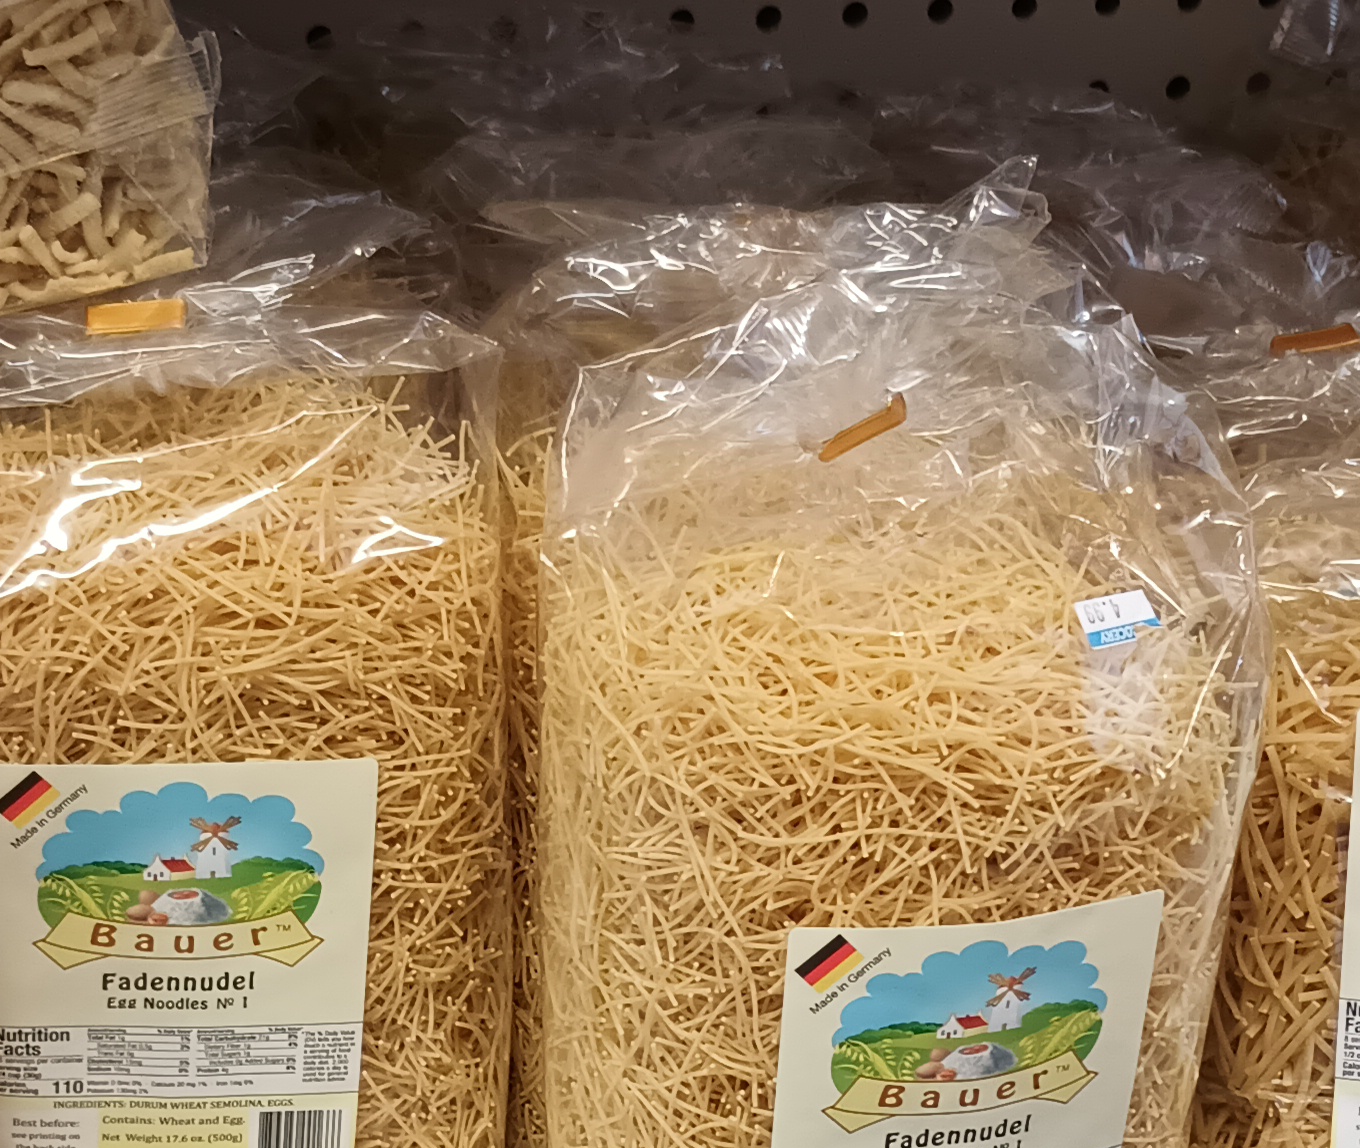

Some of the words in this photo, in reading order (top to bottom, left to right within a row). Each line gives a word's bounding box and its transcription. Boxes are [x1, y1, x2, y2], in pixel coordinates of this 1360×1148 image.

[9, 822, 39, 851] Made
[37, 814, 48, 829] in
[45, 784, 89, 819] Germany
[90, 922, 268, 955] Bauer
[102, 971, 256, 992] Fadennudel
[809, 991, 840, 1015] Made
[837, 982, 848, 999] in
[847, 947, 892, 985] Germany
[106, 996, 137, 1011] Egg
[143, 996, 208, 1011] Noodles
[52, 1080, 84, 1094] 110
[877, 1068, 1049, 1109] Bauer
[53, 1101, 126, 1109] INGREDIENTS:
[129, 1101, 168, 1109] DURUM
[169, 1100, 209, 1111] WHEAT
[12, 1118, 37, 1128] Best
[40, 1119, 80, 1128] before:
[102, 1115, 155, 1125] Contains:
[158, 1115, 195, 1126] Wheat
[198, 1115, 220, 1126] and
[102, 1132, 120, 1142] Net
[126, 1132, 163, 1144] Weight
[166, 1132, 188, 1143] 17.6
[208, 1132, 243, 1144] (500g)
